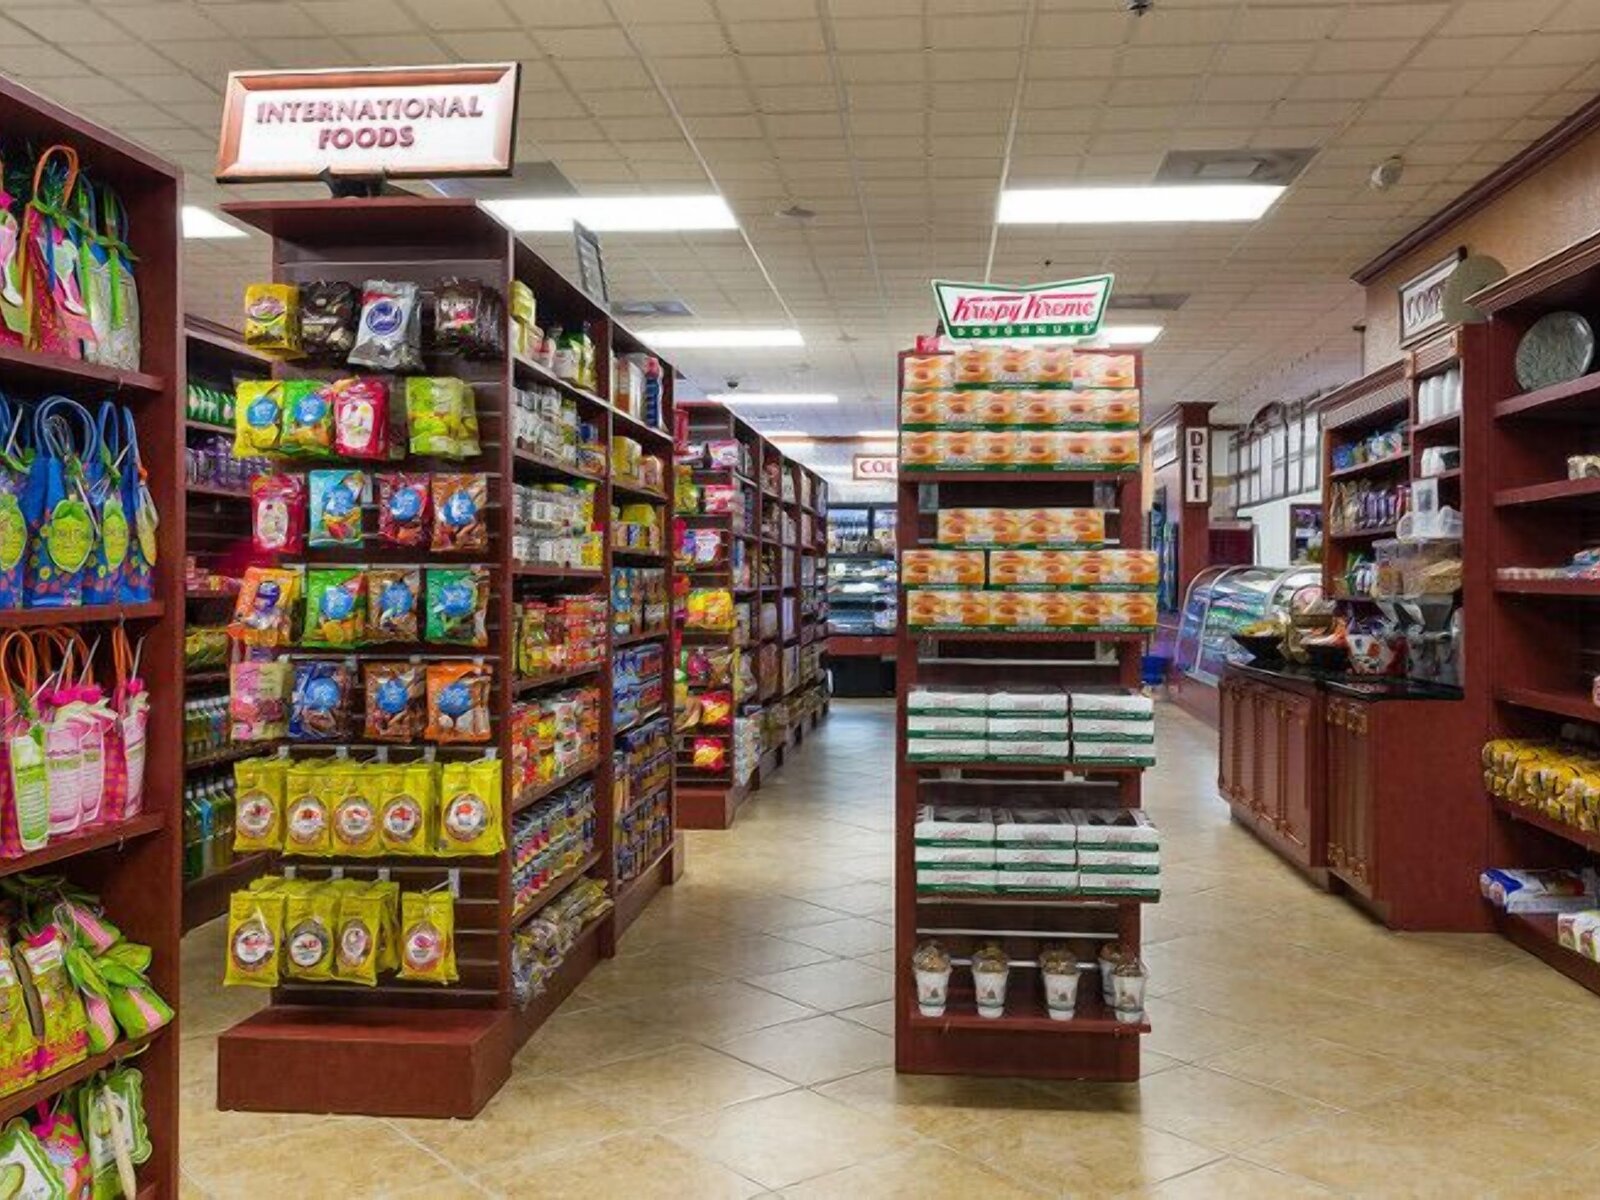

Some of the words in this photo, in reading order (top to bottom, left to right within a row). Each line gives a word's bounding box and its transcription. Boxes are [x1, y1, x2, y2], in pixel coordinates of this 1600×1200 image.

[256, 95, 484, 124] INTERNATIONAL
[318, 126, 415, 150] FOODS
[951, 295, 1024, 323] Krispy
[1022, 291, 1098, 319] Kreme
[956, 324, 1092, 336] DOUGHNUTS
[1190, 431, 1203, 499] DELI
